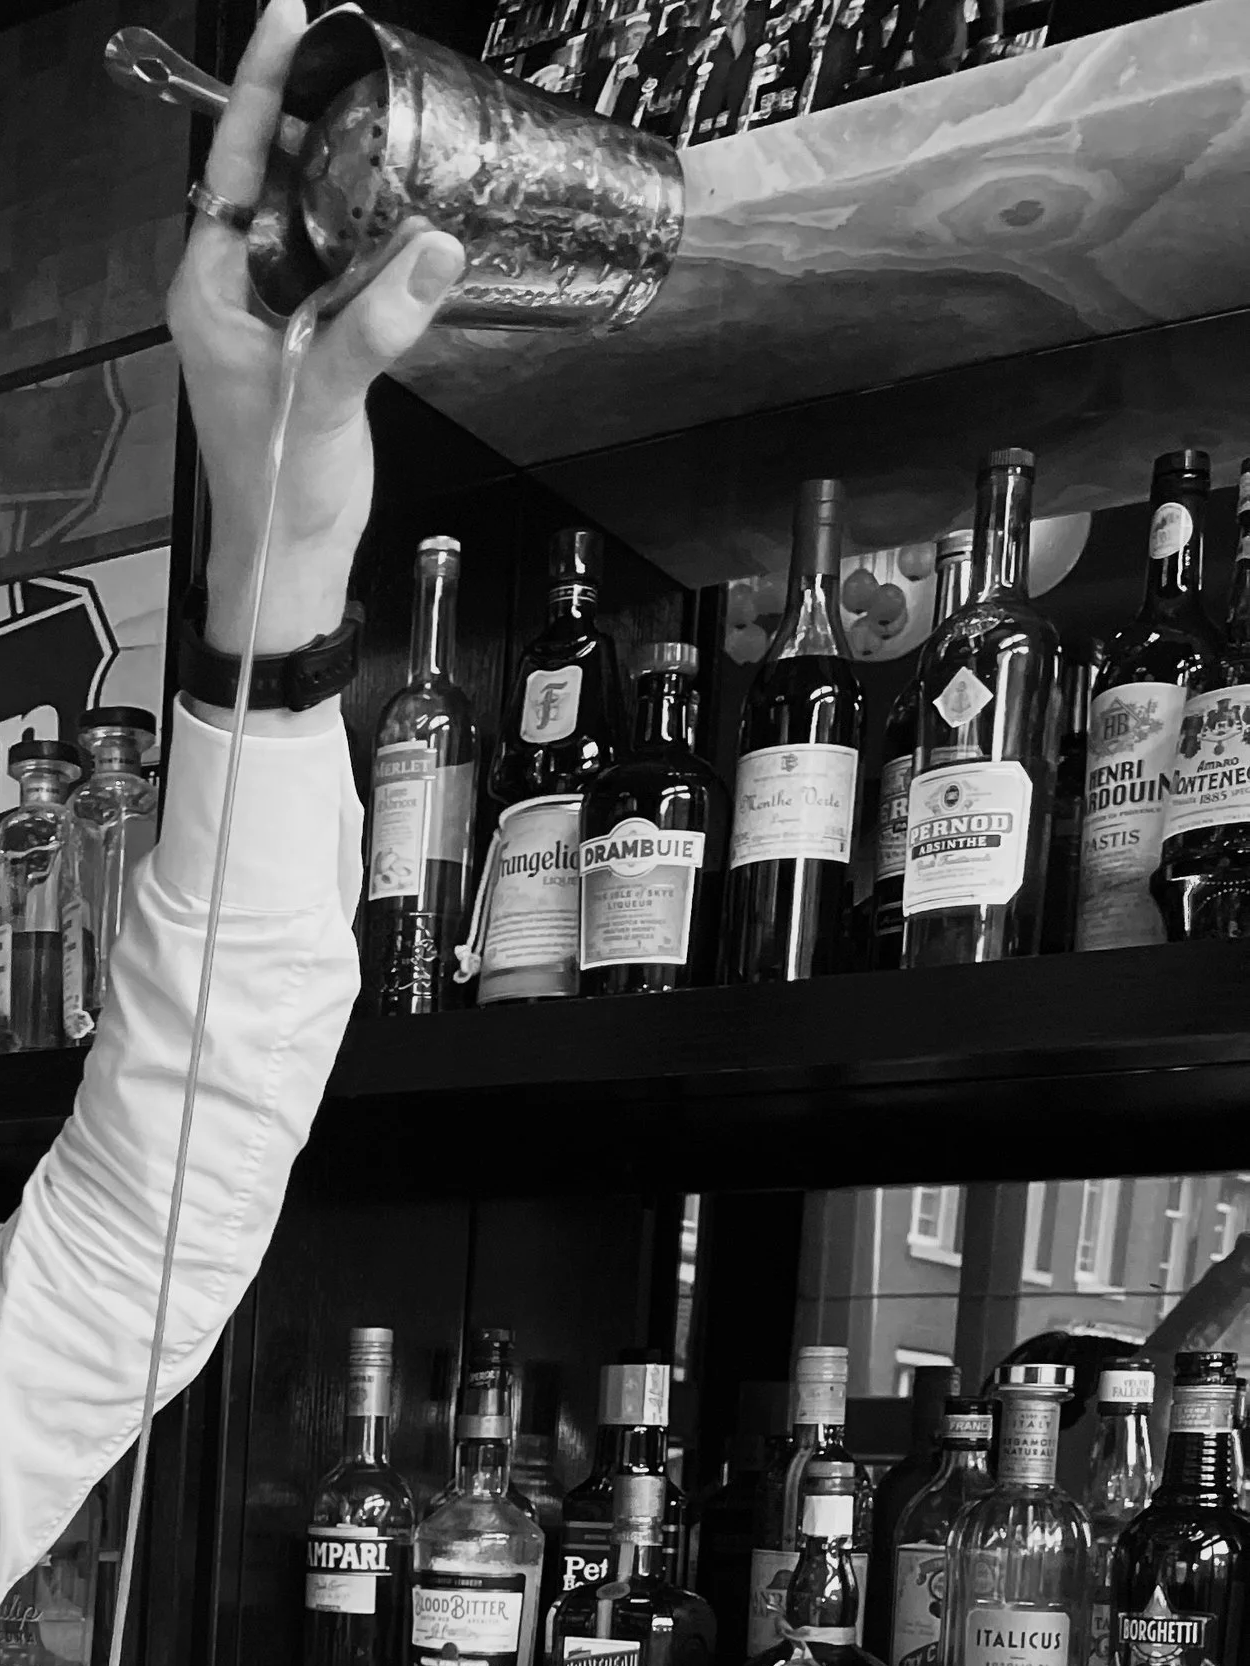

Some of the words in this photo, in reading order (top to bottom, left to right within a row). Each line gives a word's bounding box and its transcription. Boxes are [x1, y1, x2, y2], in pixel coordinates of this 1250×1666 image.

[1103, 712, 1130, 741] HB
[375, 759, 430, 777] MERLET
[1089, 758, 1144, 791] HENRI
[1196, 756, 1240, 774] AMARO
[738, 789, 793, 814] Menthe
[1199, 788, 1228, 805] 1885
[910, 813, 1010, 845] PERNOD
[584, 838, 695, 868] DRAMBUIE
[918, 835, 988, 856] ABSINTHE
[1111, 1386, 1149, 1398] FALERN
[950, 1418, 989, 1433] FRANC
[563, 1555, 609, 1581] Pet
[414, 1589, 450, 1617] BLOOD
[450, 1594, 509, 1621] BITTER
[976, 1628, 1062, 1651] ITALICUS
[1123, 1618, 1198, 1644] BORGHETTI
